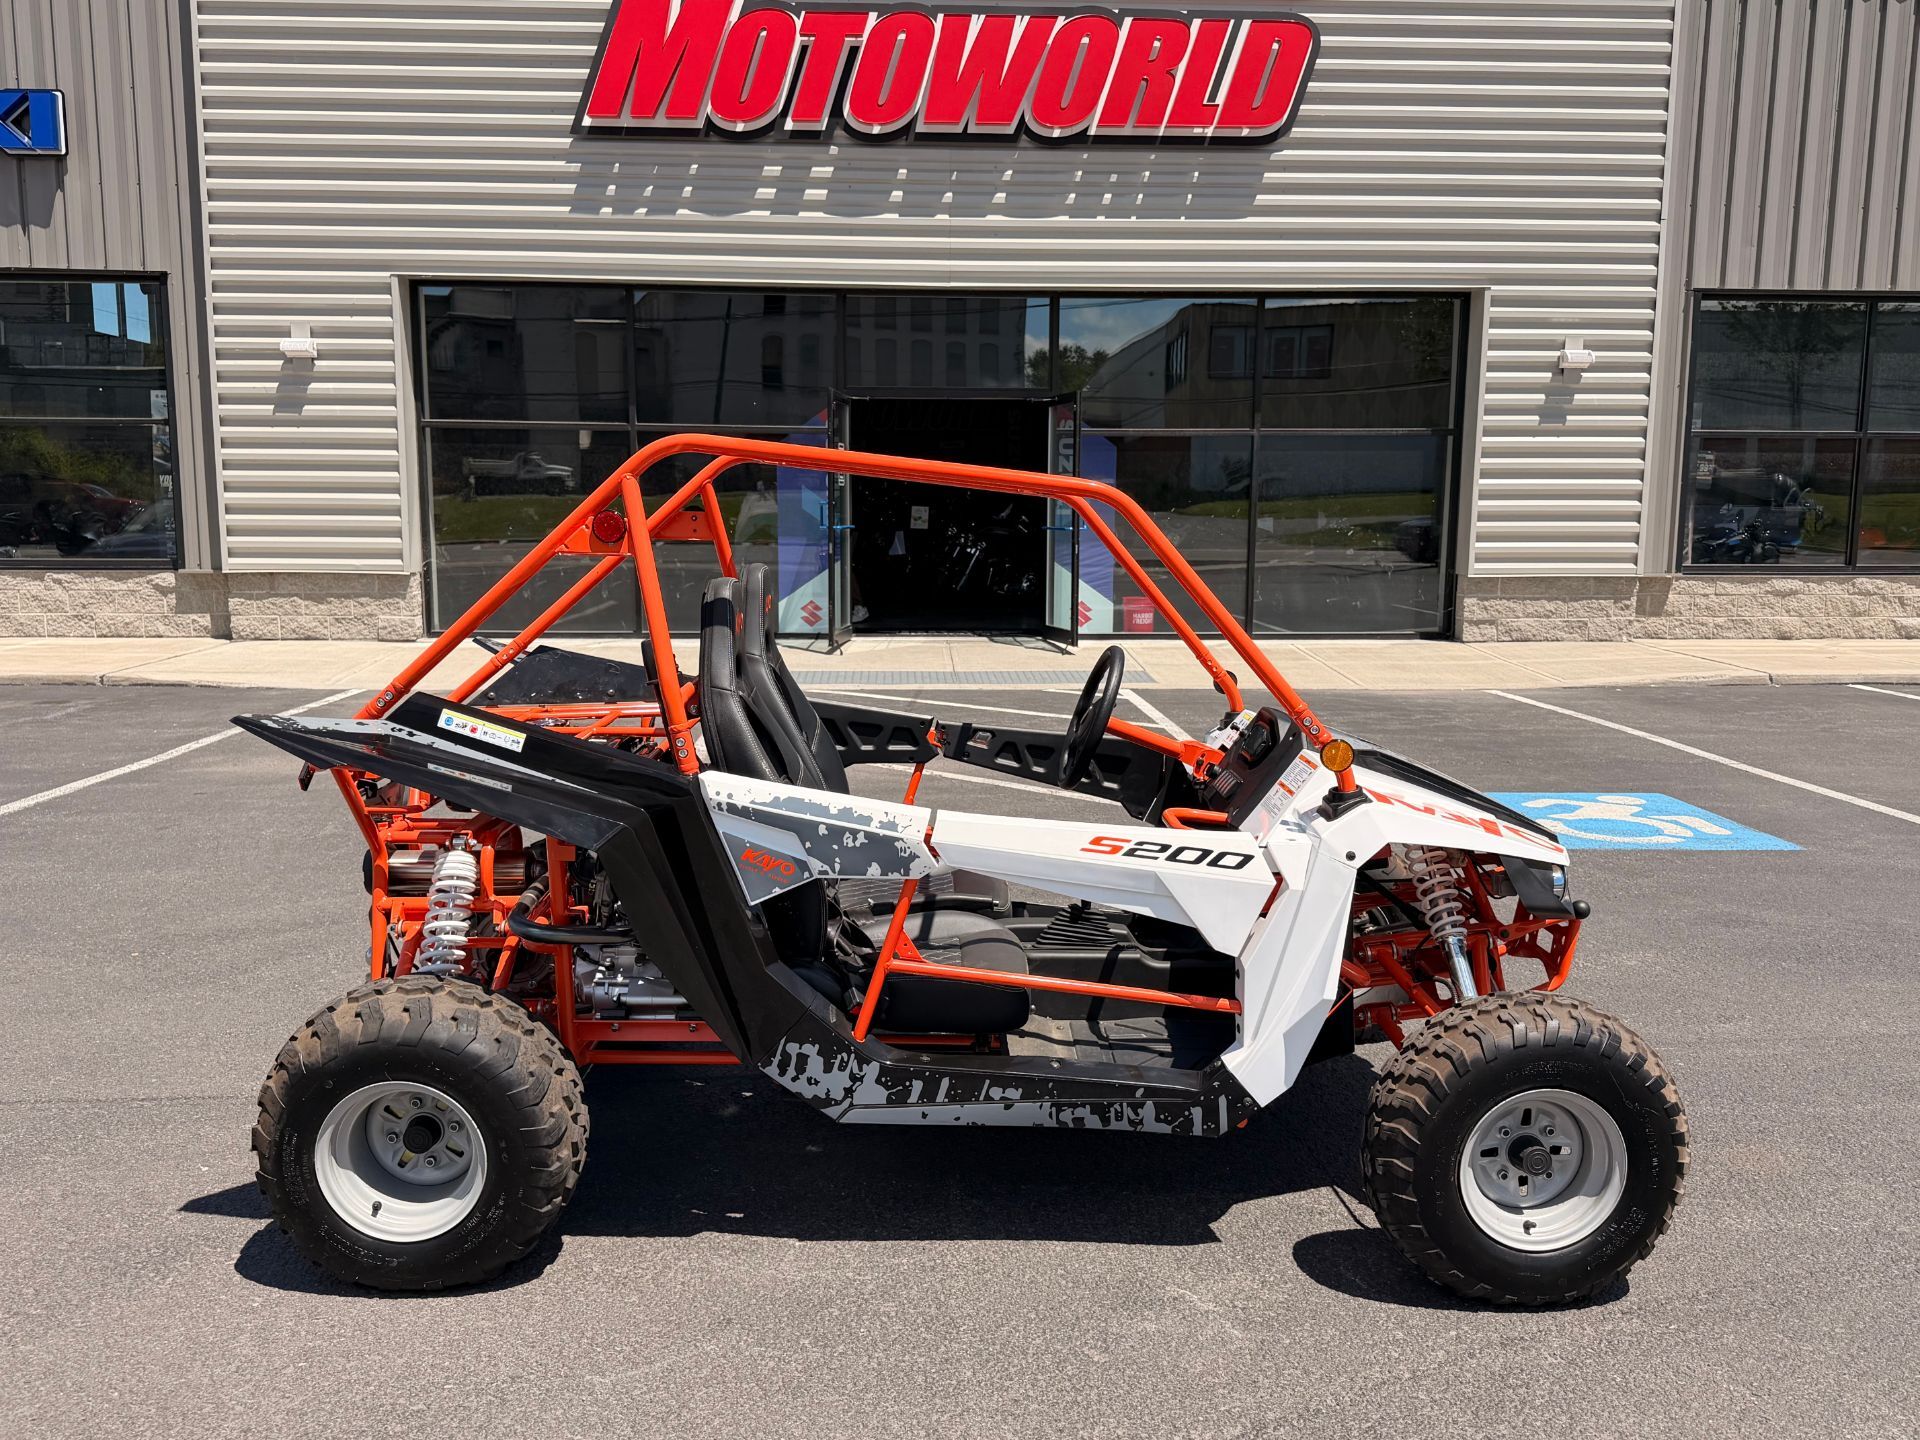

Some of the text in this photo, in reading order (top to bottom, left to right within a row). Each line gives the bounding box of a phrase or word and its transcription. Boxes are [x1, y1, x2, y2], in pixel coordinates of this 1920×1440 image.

[586, 0, 1313, 132] MOTOWORLD
[741, 848, 796, 876] KAYO
[1080, 836, 1255, 870] S200
